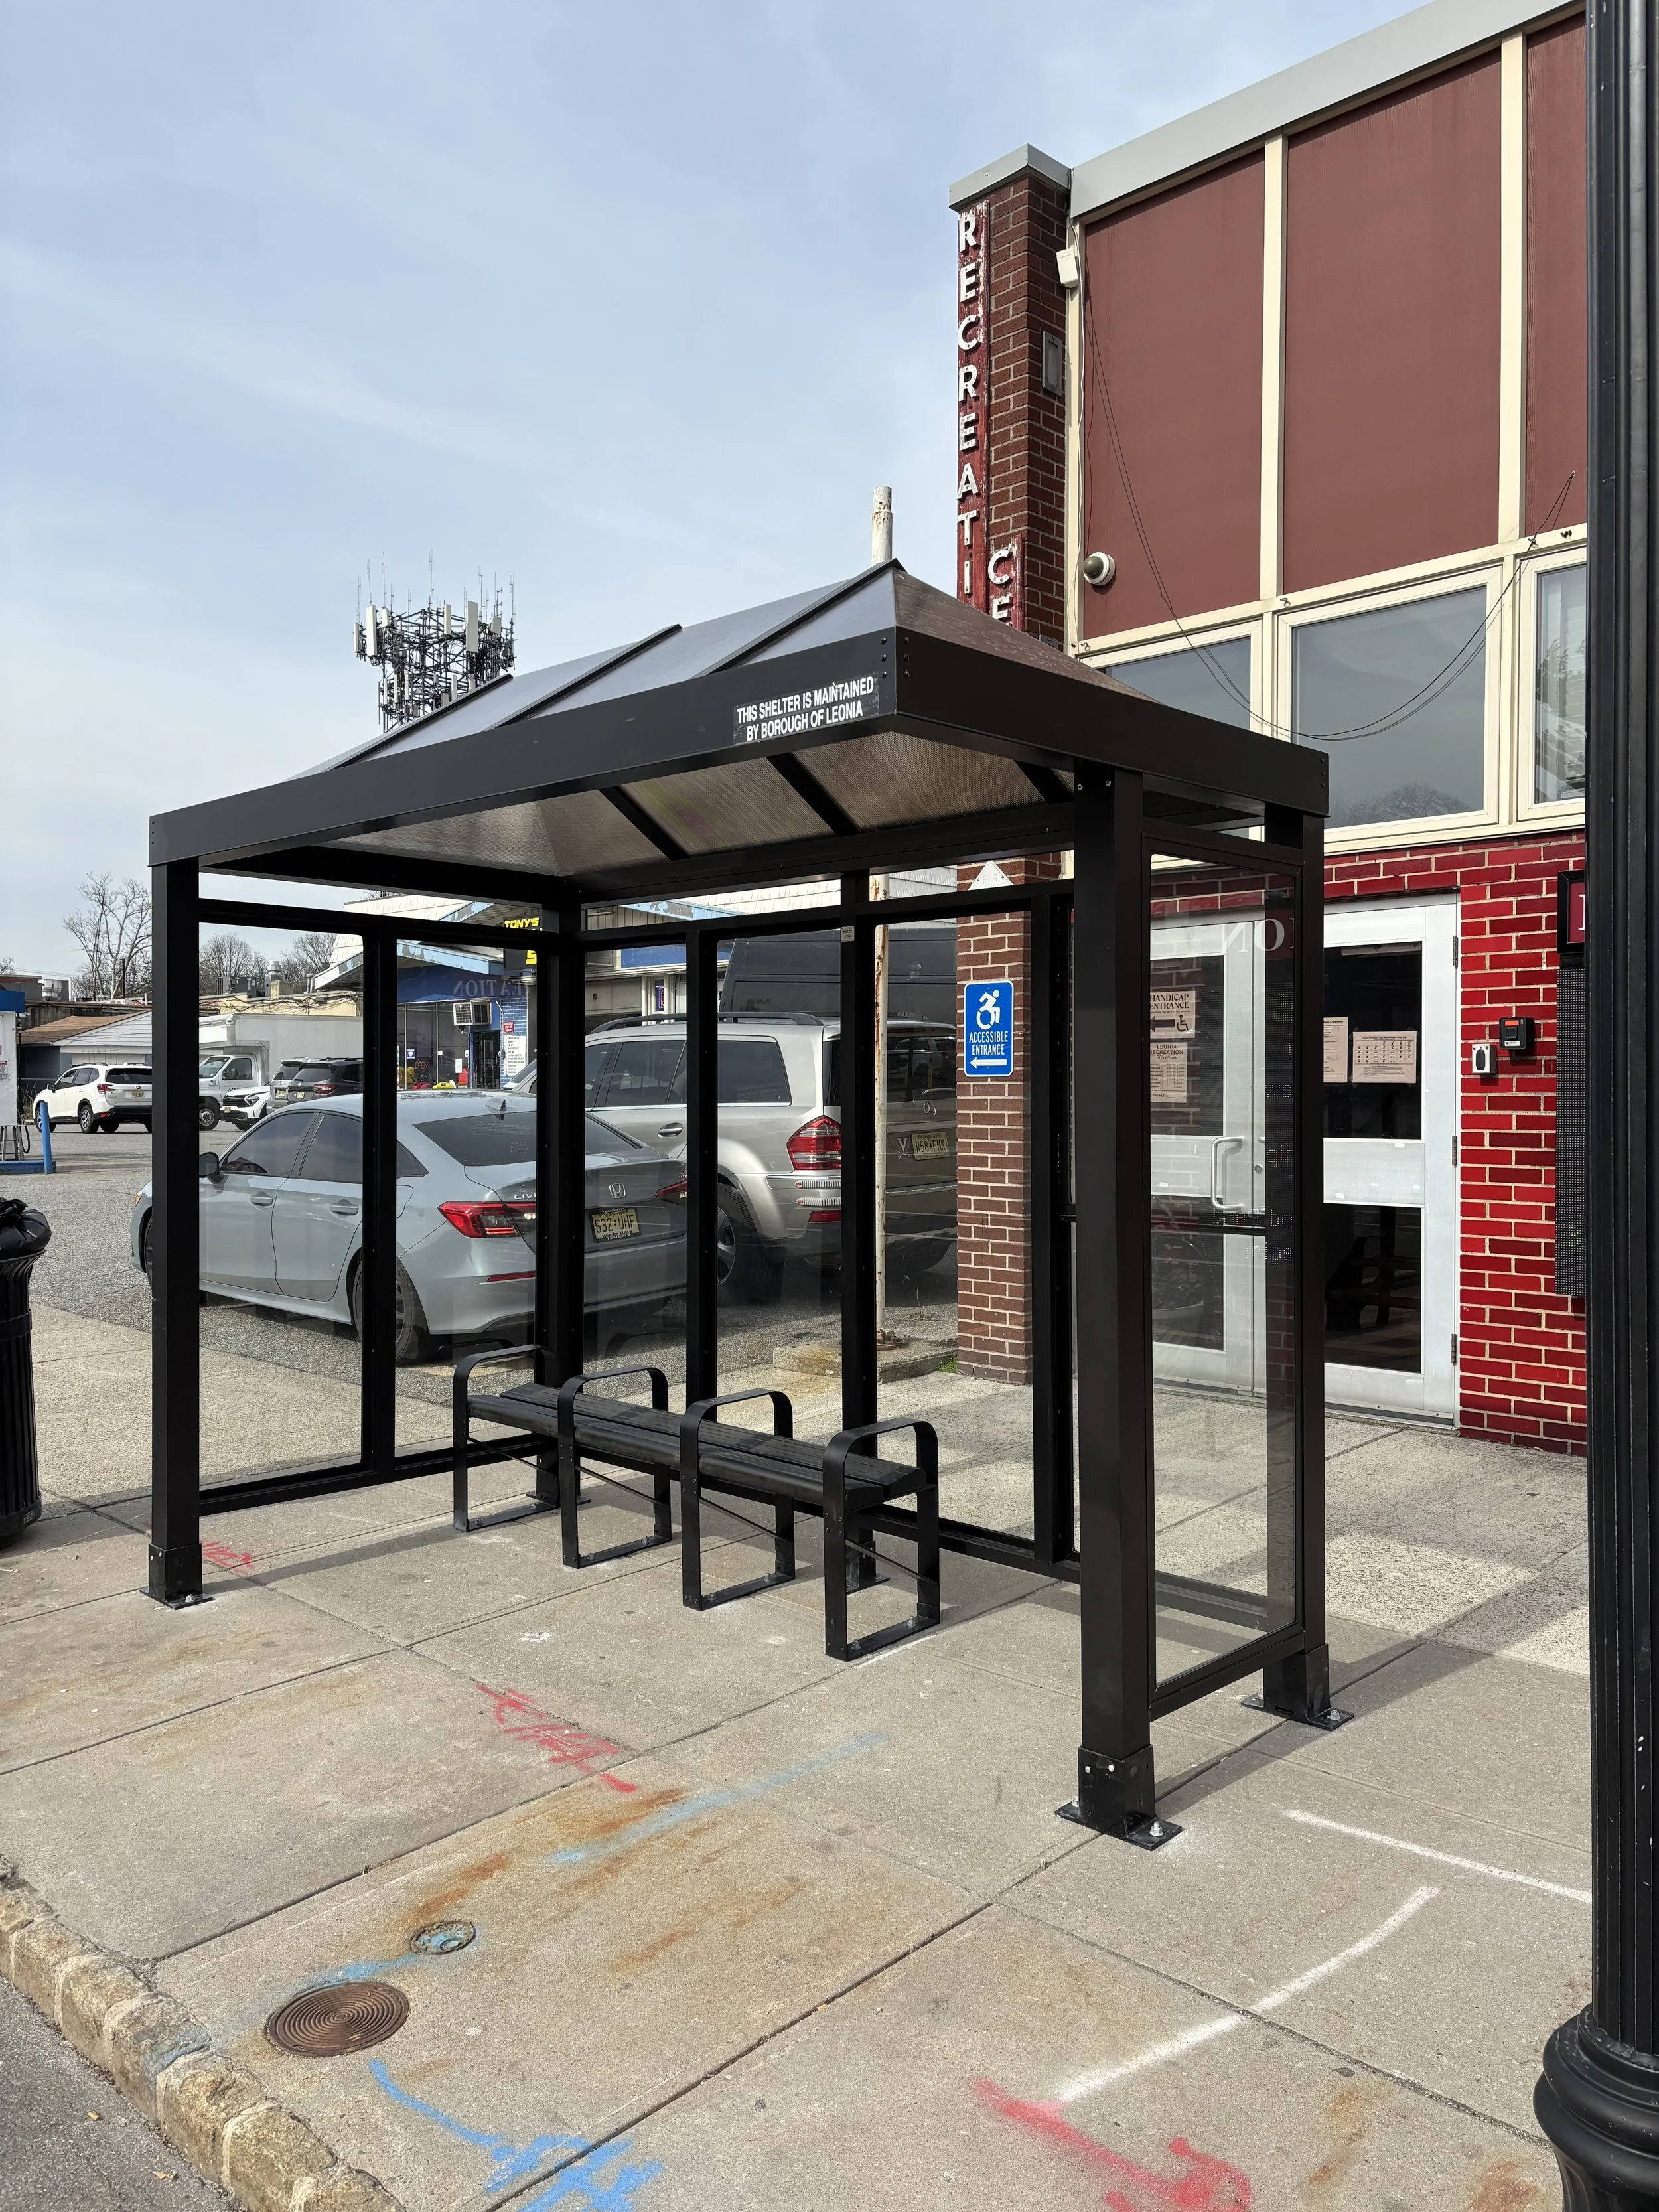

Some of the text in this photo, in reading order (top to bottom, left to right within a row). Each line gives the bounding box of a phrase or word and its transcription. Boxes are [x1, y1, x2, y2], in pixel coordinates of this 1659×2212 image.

[988, 549, 1011, 626] CE
[737, 676, 874, 724] THIS SHELTER IS MAINTAINED
[747, 700, 863, 742] BY BOROUGH OF LEONIA
[504, 917, 540, 928] TONY'S
[1150, 994, 1189, 1002] HANDICAP
[1150, 1001, 1190, 1009] ENTRANCE
[968, 1031, 1009, 1043] ACCESSIBLE
[972, 1044, 1005, 1056] ENTRANCE
